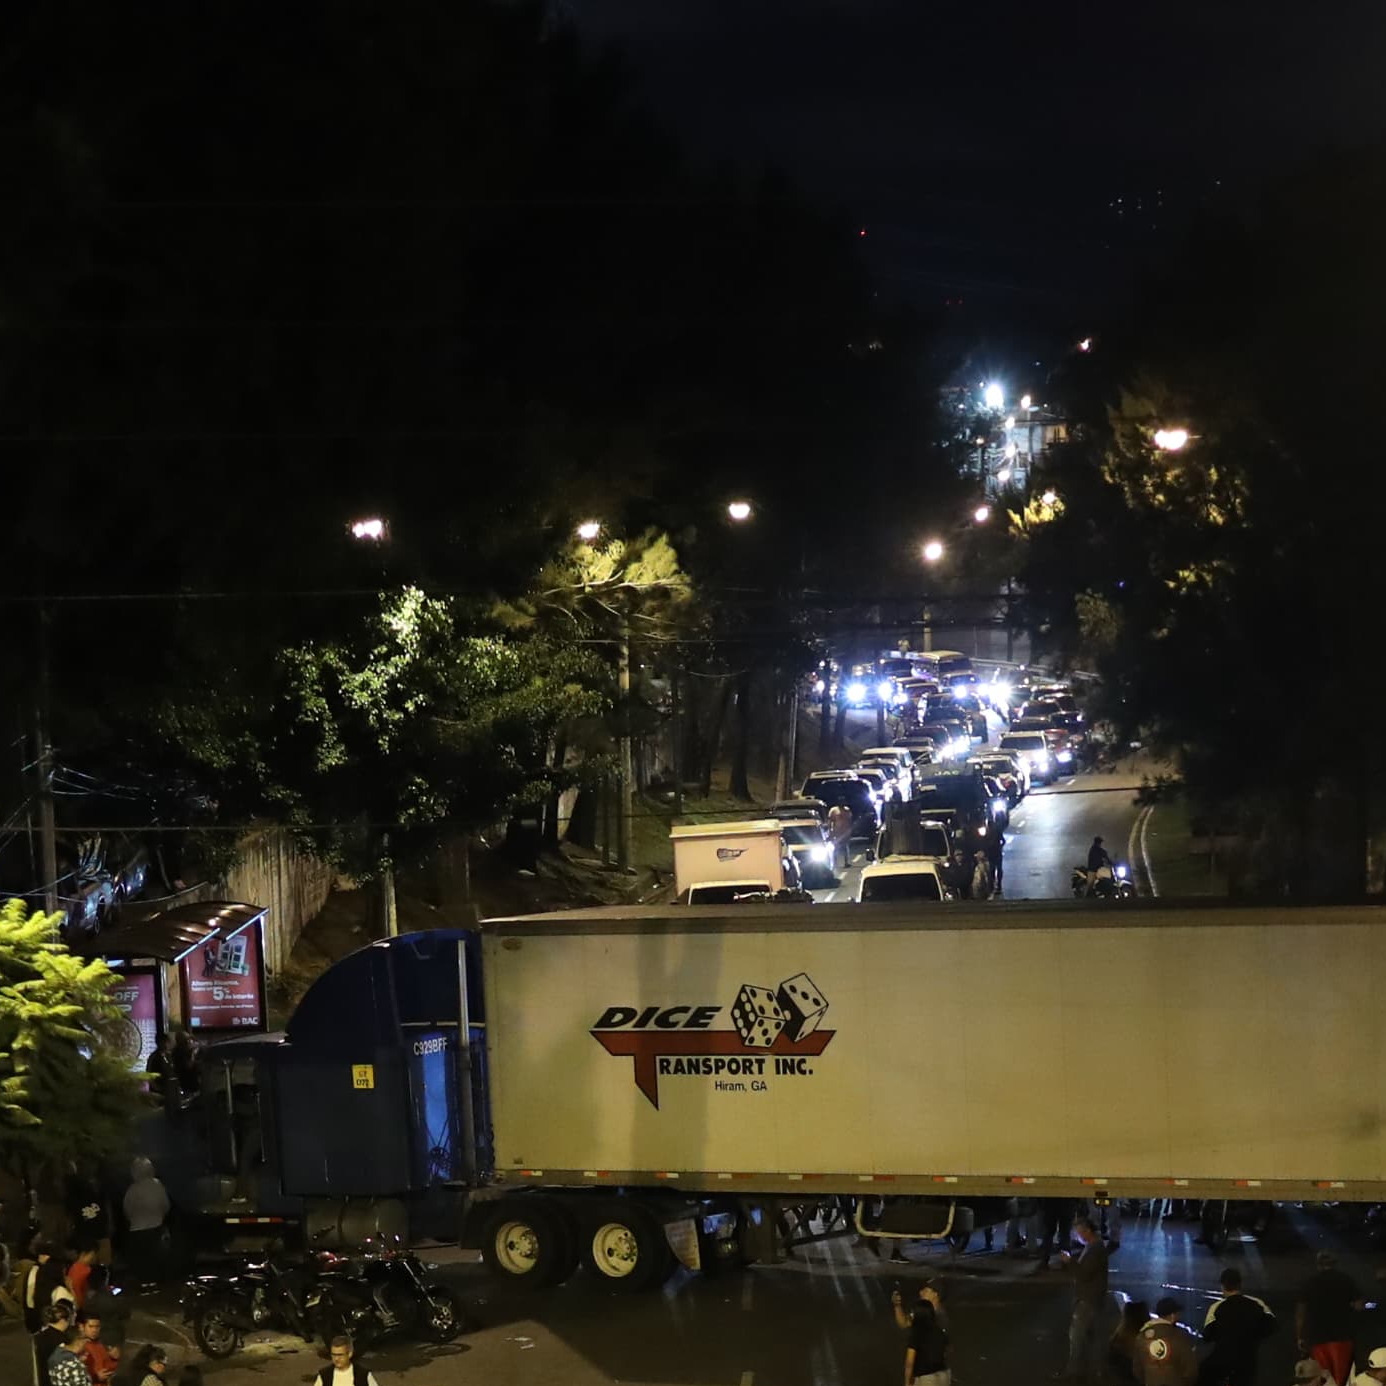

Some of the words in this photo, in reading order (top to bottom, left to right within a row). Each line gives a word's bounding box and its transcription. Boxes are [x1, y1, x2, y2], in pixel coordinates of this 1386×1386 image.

[593, 1006, 723, 1029] DICE
[775, 1057, 813, 1076] INC.
[714, 1080, 747, 1092] Hiram,
[751, 1080, 767, 1091] GA
